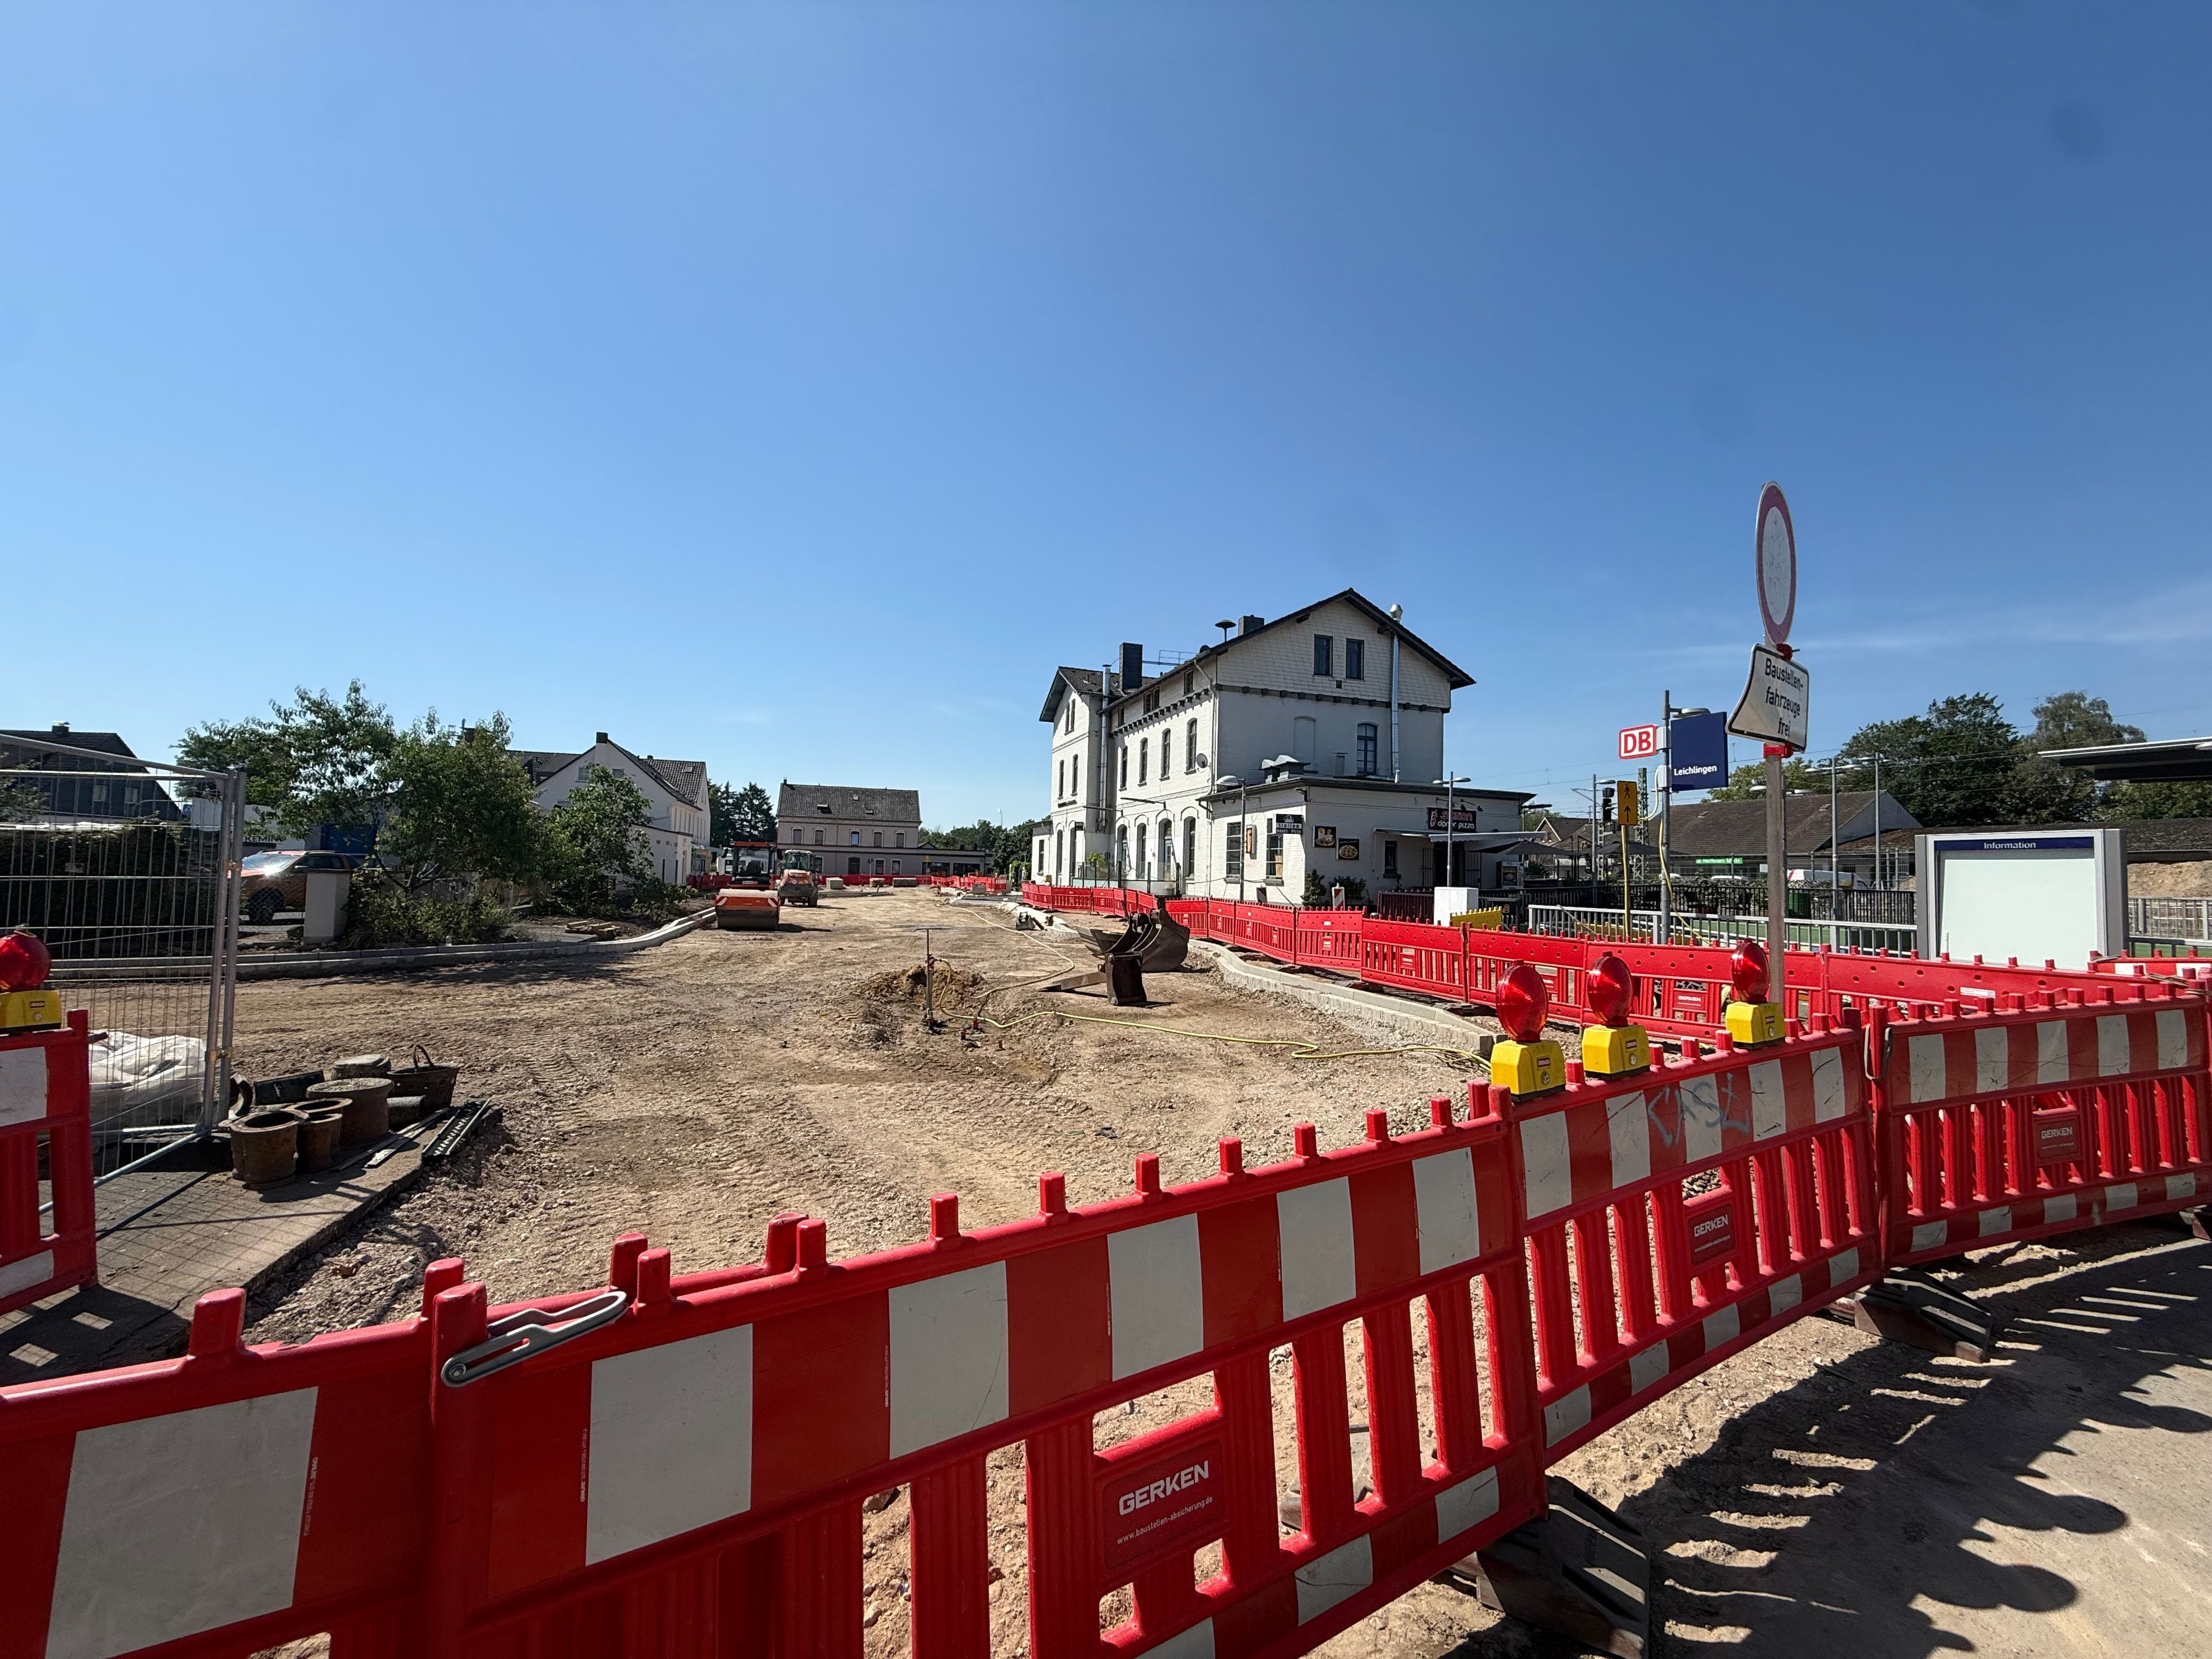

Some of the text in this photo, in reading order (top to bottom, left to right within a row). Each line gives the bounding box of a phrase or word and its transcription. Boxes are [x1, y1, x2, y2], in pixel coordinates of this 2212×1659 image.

[1765, 658, 1803, 691] Baustellen-
[1765, 686, 1801, 718] fahrzeuge
[1777, 717, 1791, 738] frei
[1624, 731, 1651, 754] DB
[1674, 765, 1717, 776] Leichlingen
[1438, 819, 1457, 828] dönr
[2041, 1126, 2073, 1139] GERKEN
[1694, 1214, 1729, 1237] GERKEN
[1119, 1460, 1209, 1516] GERKEN
[1117, 1496, 1213, 1545] www.baustellen-absicherung.de
